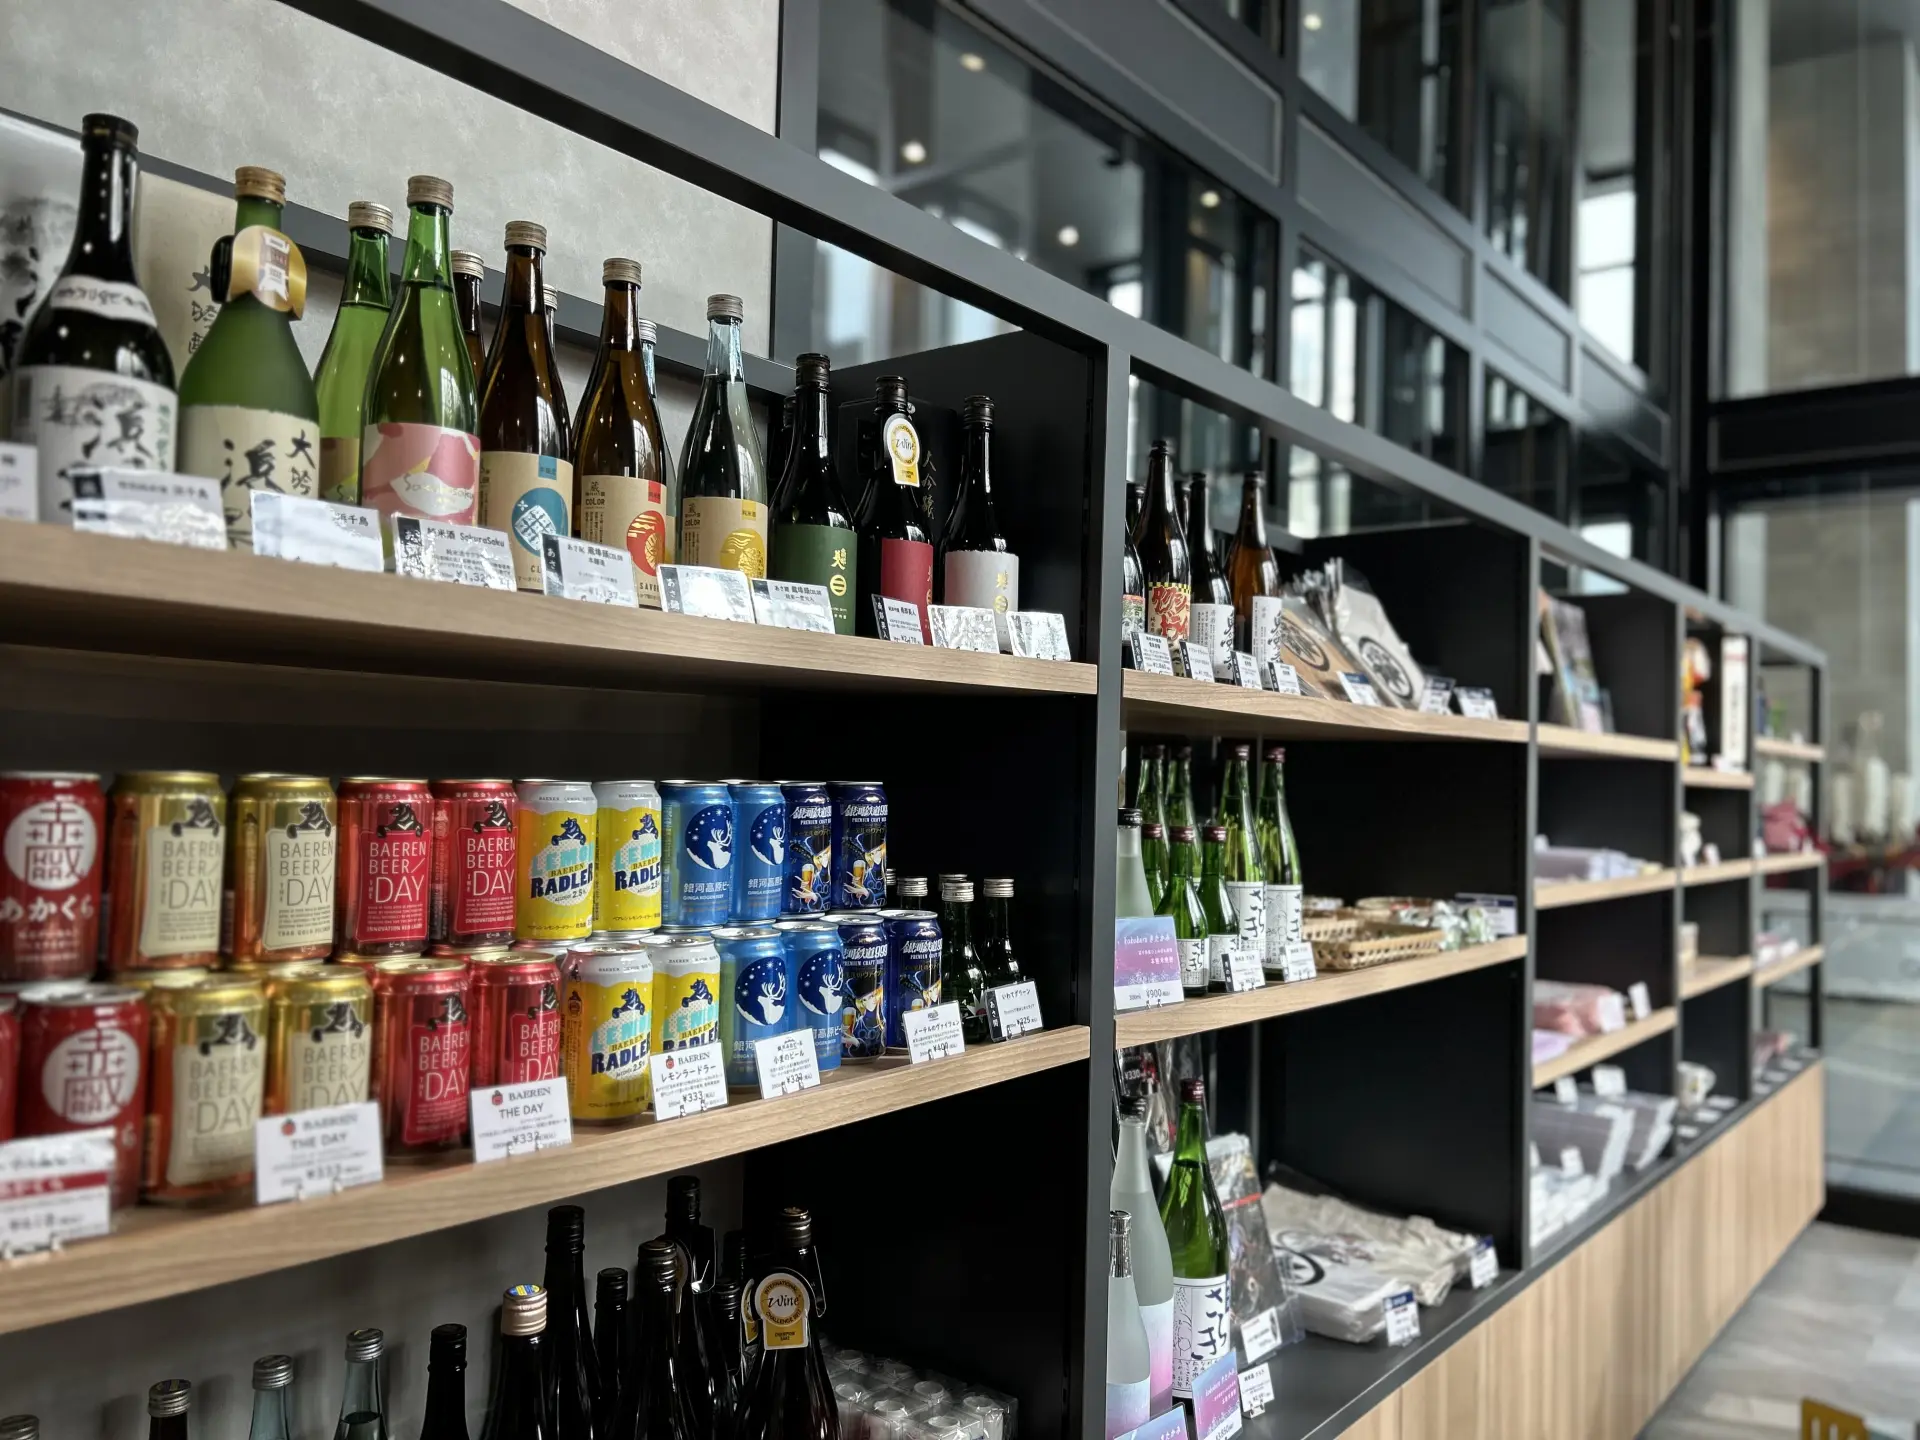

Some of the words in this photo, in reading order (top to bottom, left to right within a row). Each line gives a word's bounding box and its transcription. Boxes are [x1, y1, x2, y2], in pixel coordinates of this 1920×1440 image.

[585, 498, 606, 506] COLOR
[459, 532, 505, 547] SakuraSaku
[280, 840, 334, 859] BAEREN
[369, 840, 427, 858] BAEREN
[466, 836, 516, 853] BAEREN
[549, 862, 585, 877] BAEREN
[473, 869, 515, 897] DAY
[530, 862, 594, 899] RADLER
[168, 879, 220, 910] DAY
[286, 876, 333, 907] DAY
[375, 875, 425, 904] DAY
[1001, 988, 1031, 1001] いわてグリーン
[1146, 988, 1163, 999] ¥900
[681, 1022, 712, 1039] BAEREN
[611, 1033, 644, 1051] BAEREN
[678, 1051, 711, 1066] BAEREN
[773, 1049, 805, 1065] 小麦のビール
[661, 1064, 717, 1083] レモンラードラー
[425, 1066, 469, 1102] DAY
[508, 1087, 551, 1102] BAEREN
[682, 1090, 704, 1103] ¥333
[195, 1096, 258, 1135] DAY
[498, 1106, 521, 1119] THE
[523, 1102, 544, 1116] DAY
[290, 1137, 316, 1151] THE
[321, 1131, 348, 1145] DAY
[768, 1294, 800, 1308] Wine
